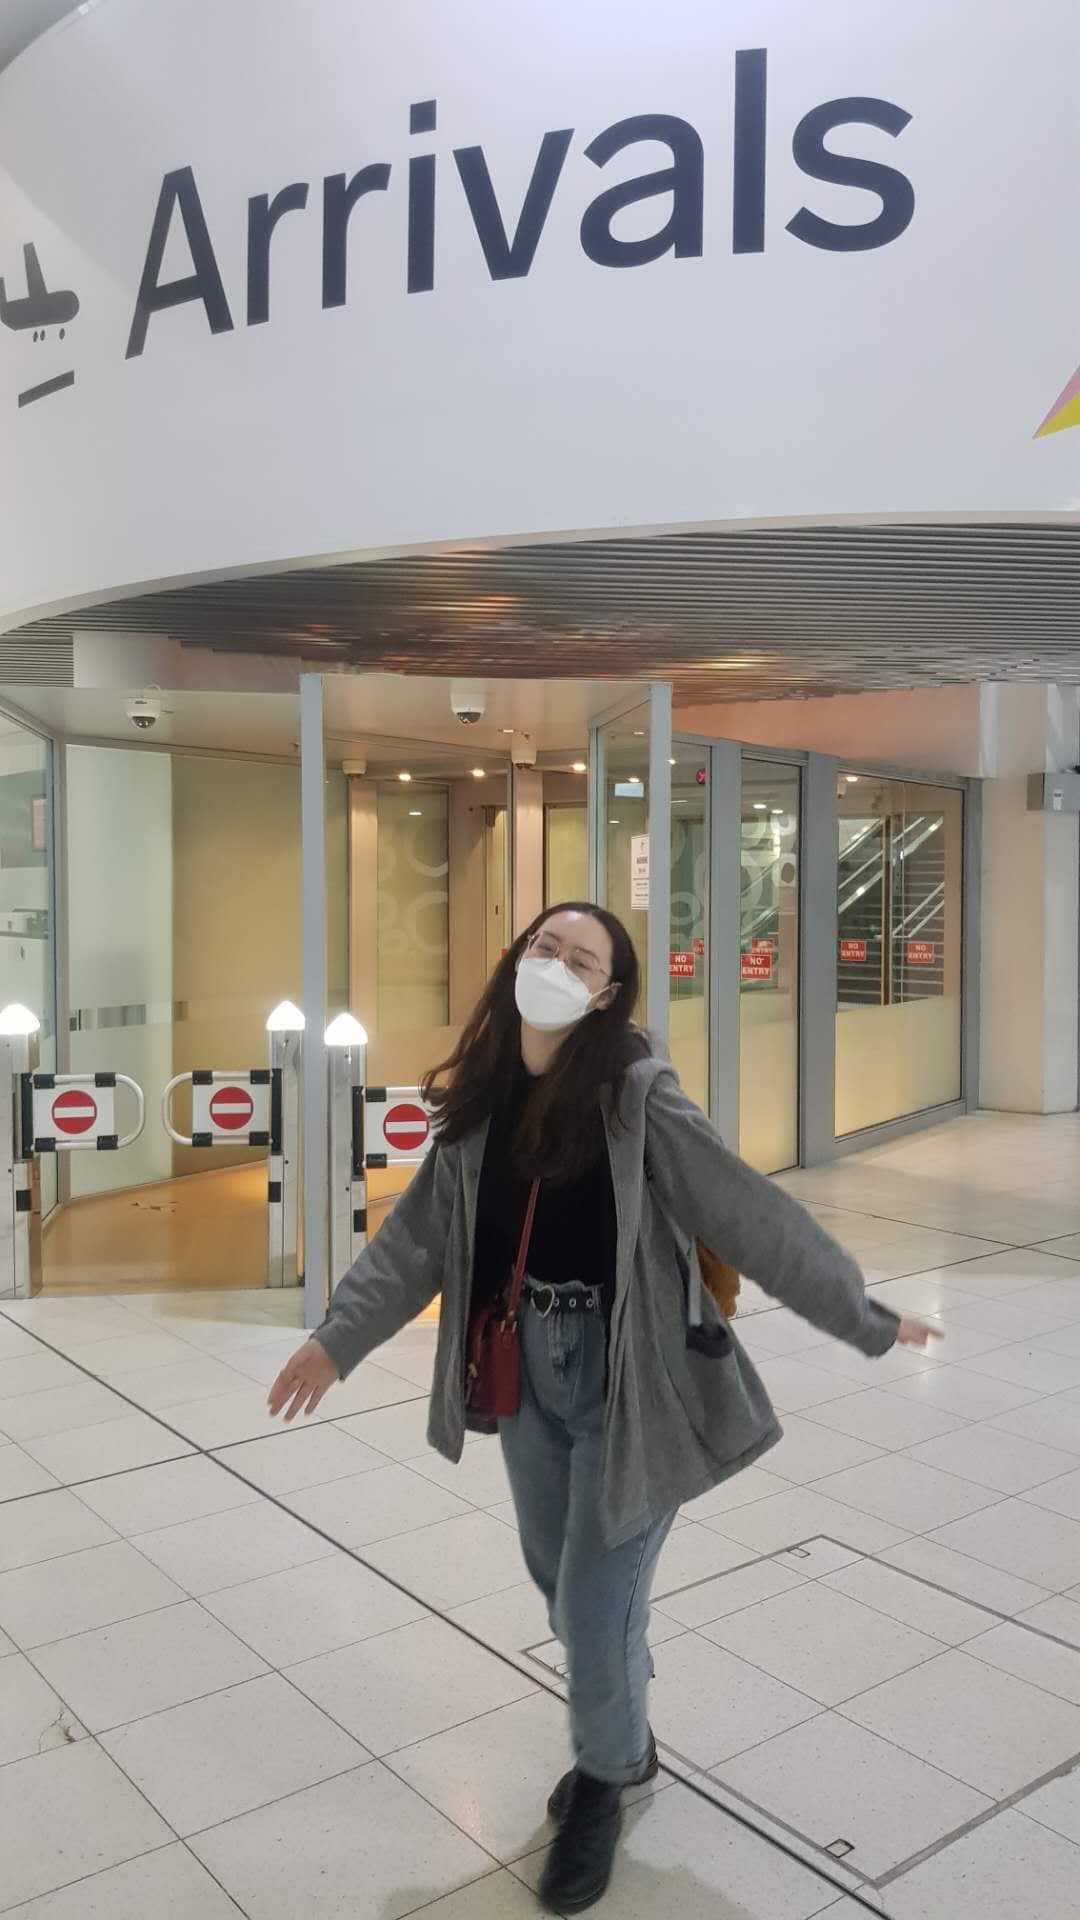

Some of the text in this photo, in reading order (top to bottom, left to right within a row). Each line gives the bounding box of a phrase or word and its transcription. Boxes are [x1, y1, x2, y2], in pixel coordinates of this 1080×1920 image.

[125, 48, 916, 360] Arrivals
[841, 950, 865, 958] ENTRY
[908, 952, 932, 960] ENTRY
[674, 955, 687, 963] NO
[750, 957, 762, 965] NO
[742, 967, 771, 975] ENTRY
